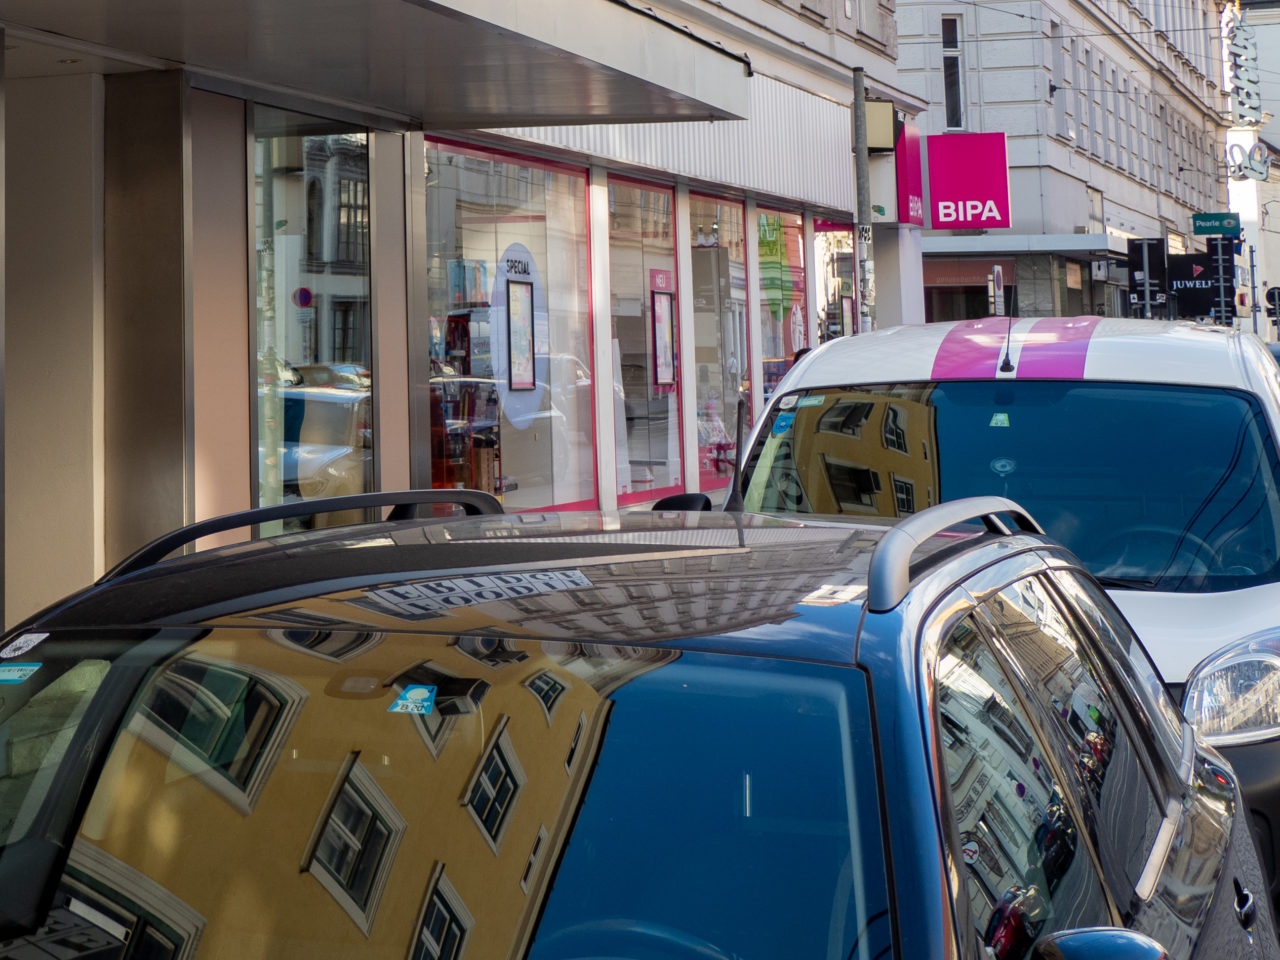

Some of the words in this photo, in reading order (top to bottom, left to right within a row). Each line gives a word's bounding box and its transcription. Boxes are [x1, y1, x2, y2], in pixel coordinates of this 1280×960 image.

[908, 195, 922, 218] BIPA
[938, 200, 1001, 222] BIPA
[507, 259, 530, 275] SPECIAL
[655, 274, 665, 287] NEU
[1172, 279, 1216, 290] JUWELI
